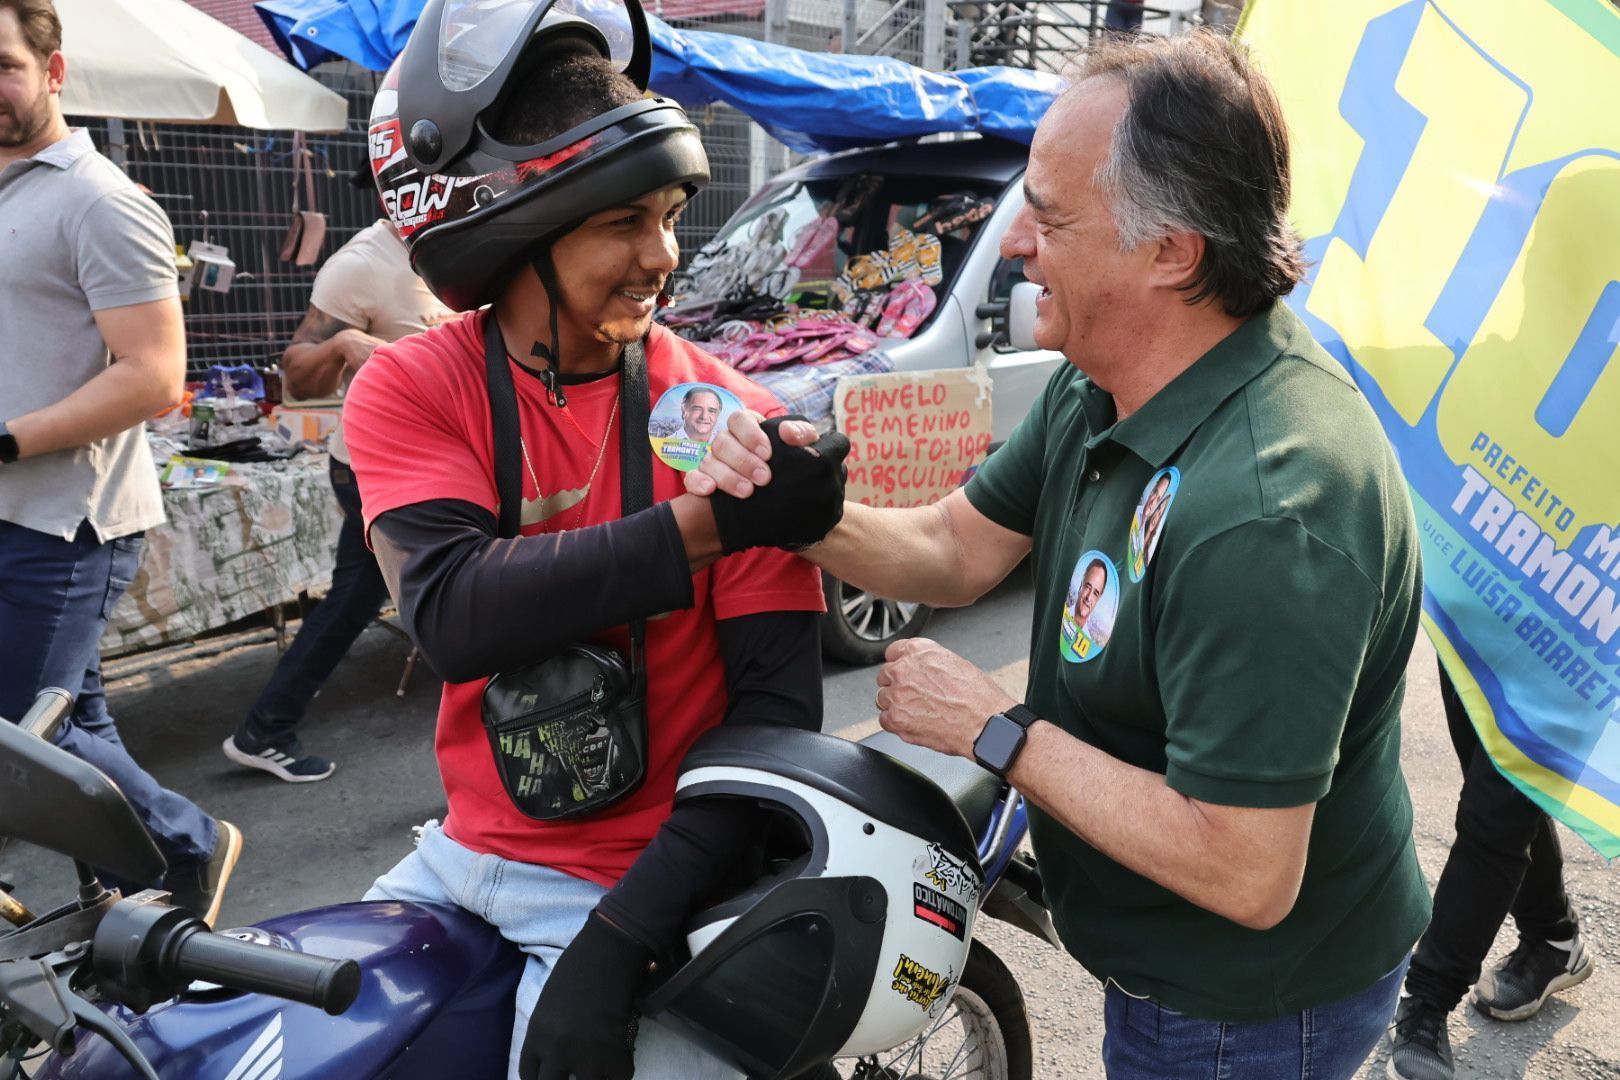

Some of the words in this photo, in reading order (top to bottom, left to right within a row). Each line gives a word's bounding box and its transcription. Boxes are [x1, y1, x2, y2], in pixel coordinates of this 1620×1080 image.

[1451, 465, 1620, 657] TRAMON
[1470, 431, 1576, 532] PREFEITO
[1423, 519, 1455, 556] VICE
[1450, 547, 1523, 624] LUÍSA
[1514, 611, 1620, 724] BARRET
